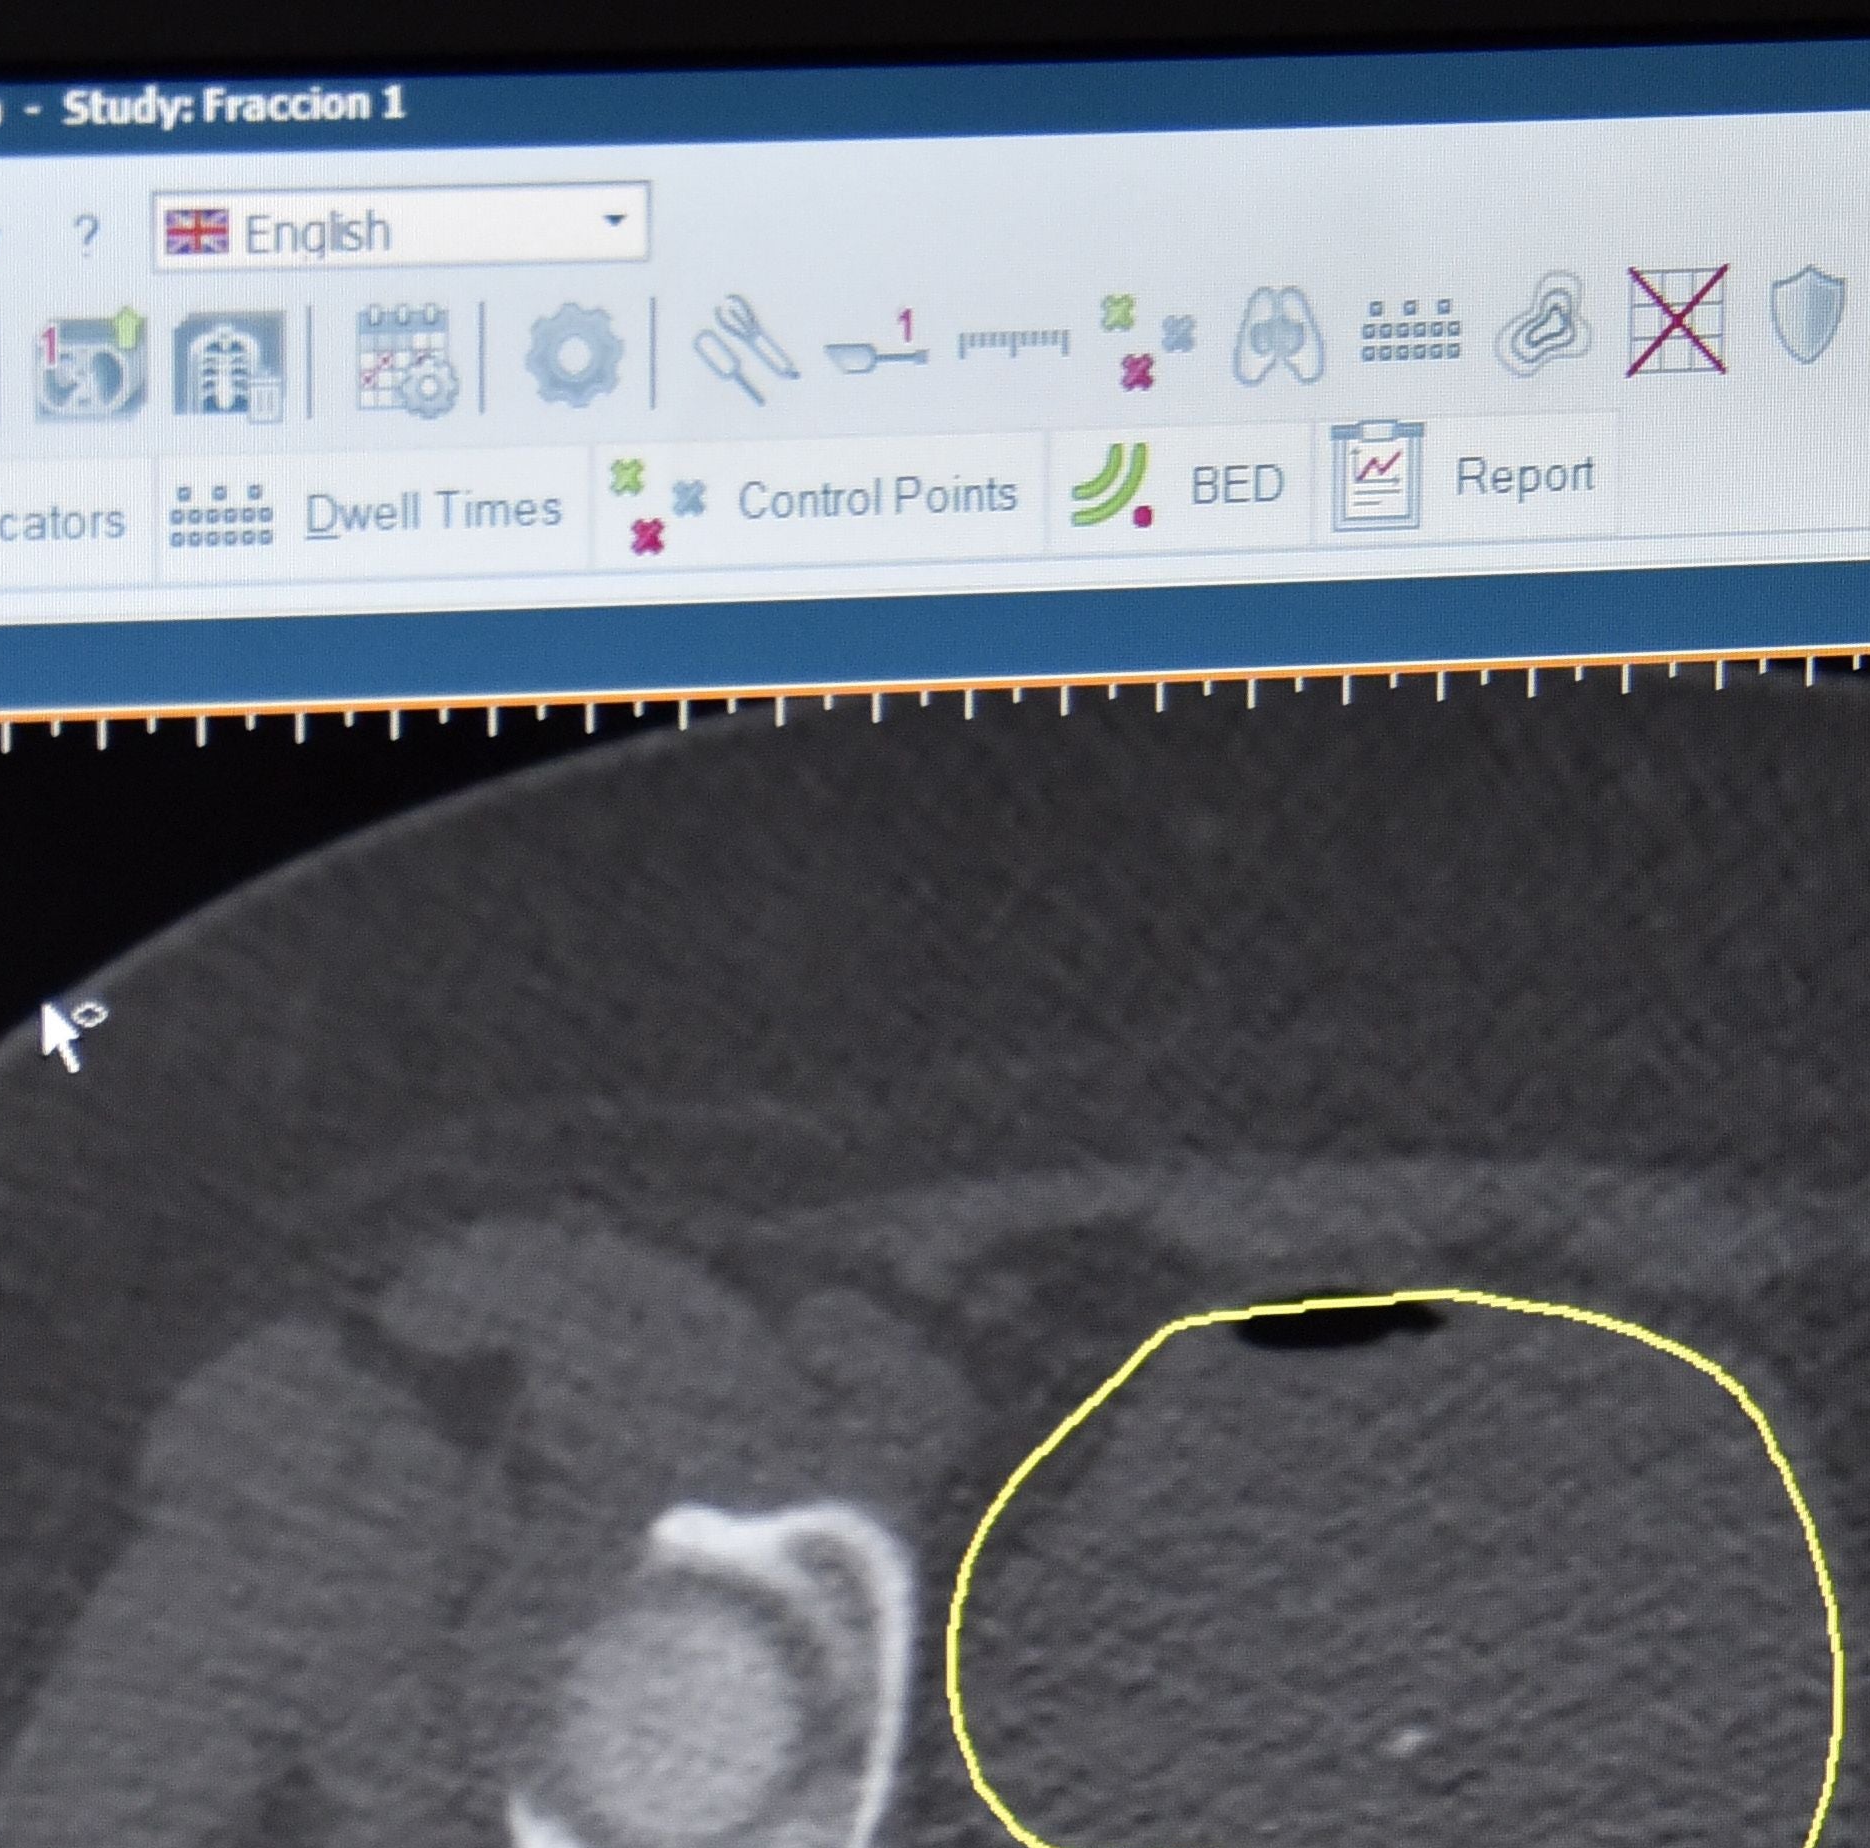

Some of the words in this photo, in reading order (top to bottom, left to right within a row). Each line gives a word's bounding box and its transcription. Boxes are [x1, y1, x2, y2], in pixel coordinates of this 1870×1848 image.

[62, 84, 194, 131] Study:
[201, 84, 371, 123] Fraccion
[382, 83, 406, 121] 1
[74, 213, 101, 257] ?
[245, 209, 392, 261] English
[739, 476, 882, 520] Control
[895, 472, 1020, 515] Points
[1192, 465, 1286, 505] BED
[1456, 453, 1595, 500] Report
[305, 490, 421, 536] Dwell
[435, 489, 563, 529] Times
